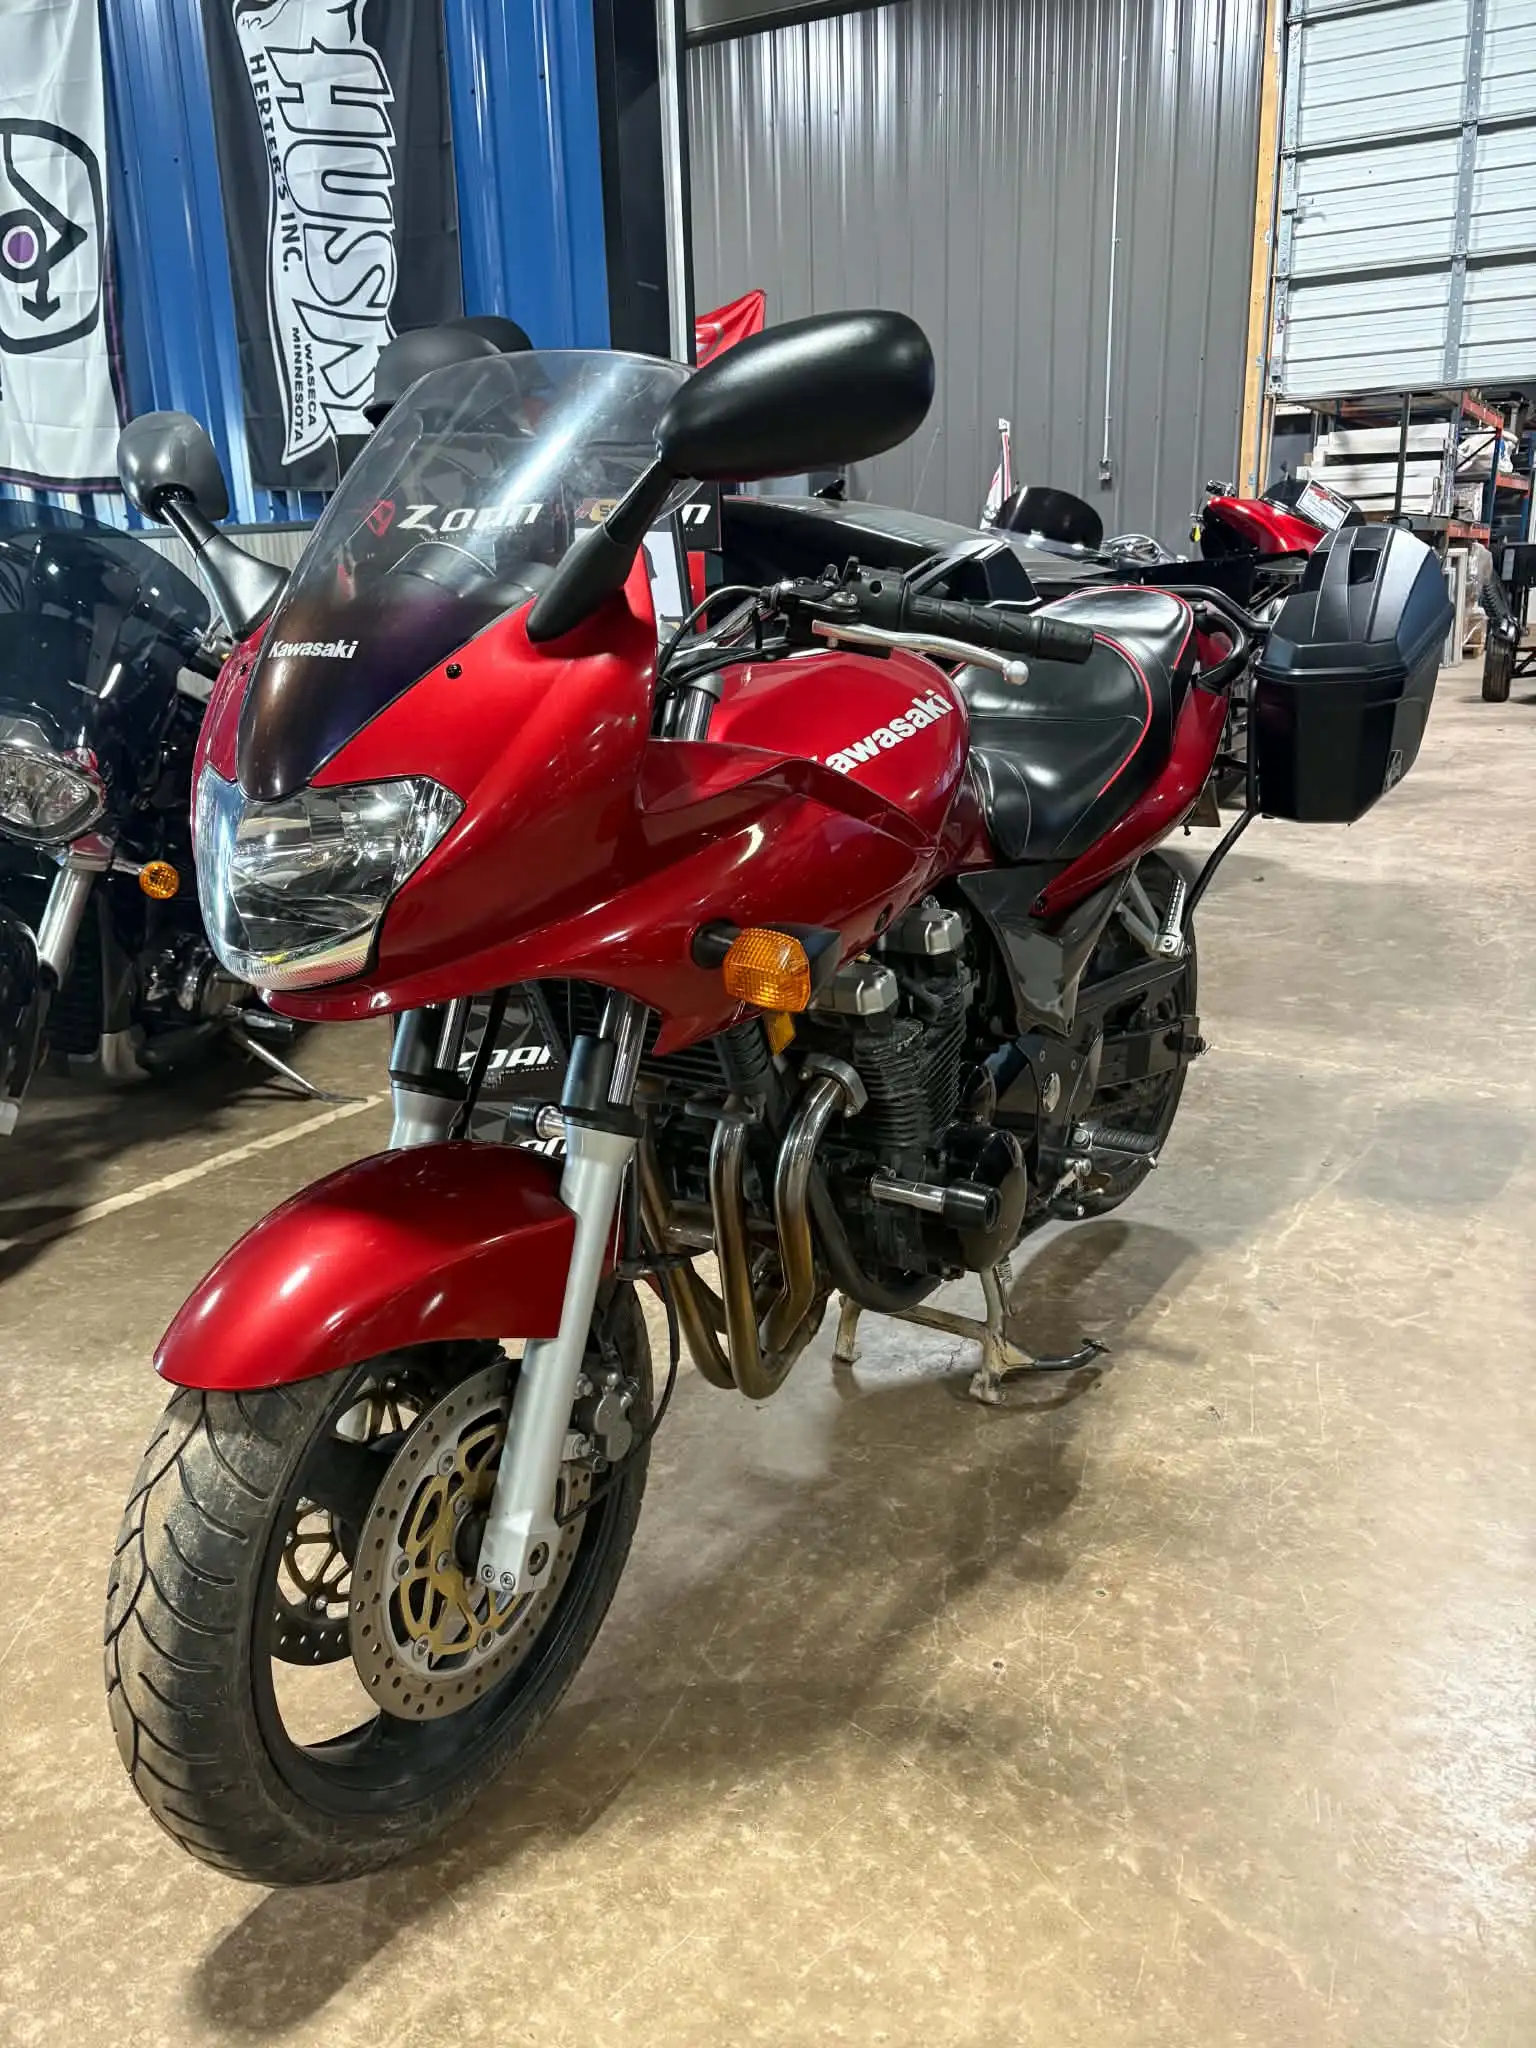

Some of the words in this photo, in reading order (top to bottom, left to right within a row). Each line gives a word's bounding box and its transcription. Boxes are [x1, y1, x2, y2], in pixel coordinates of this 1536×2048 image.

[249, 53, 290, 201] HERTER'S
[280, 211, 303, 273] INC.
[291, 326, 305, 442] MINNESOTA
[304, 342, 318, 427] WASECA
[268, 639, 360, 659] Kawasaki
[809, 688, 955, 775] awasaki
